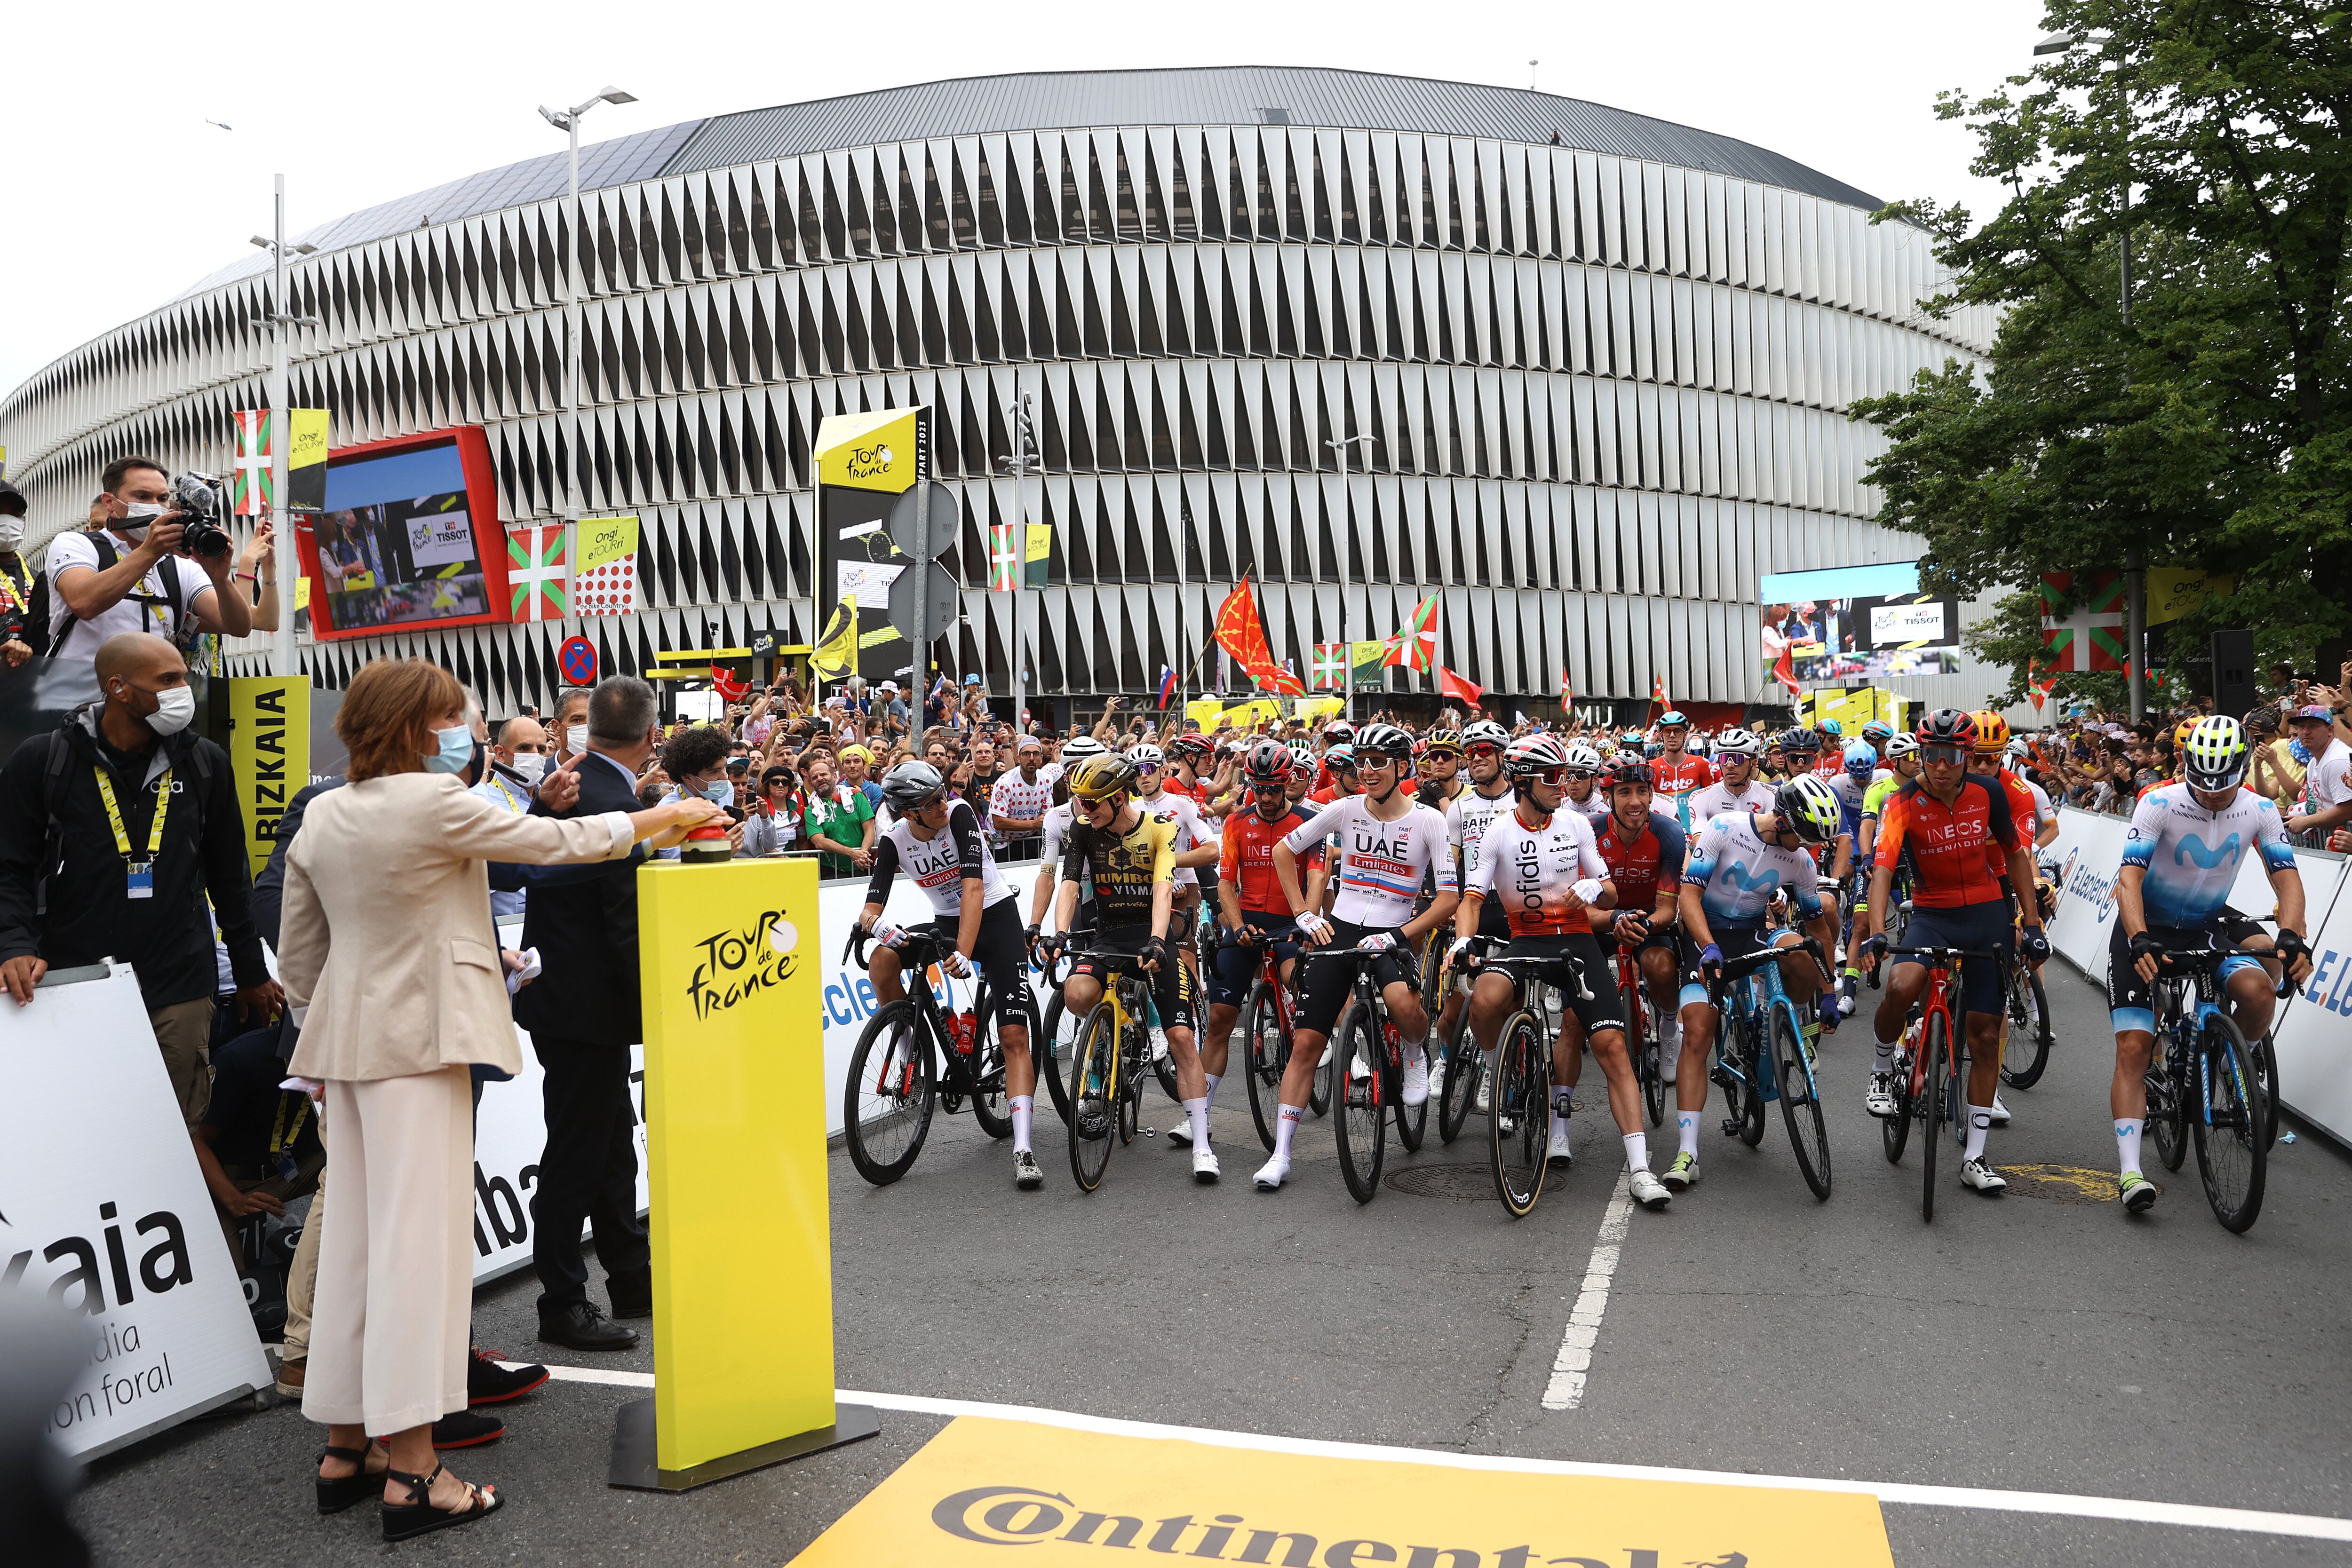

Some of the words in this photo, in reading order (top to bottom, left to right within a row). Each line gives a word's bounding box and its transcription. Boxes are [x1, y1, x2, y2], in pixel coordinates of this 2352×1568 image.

[299, 429, 319, 442] Ongi
[918, 449, 926, 480] ÉPART
[436, 530, 468, 542] TISSOT
[596, 526, 619, 544] Ongi
[588, 537, 624, 560] eTOURri
[2173, 574, 2206, 594] Ongi
[1904, 617, 1940, 625] TISSOT
[1133, 698, 1153, 711] 20
[255, 688, 286, 841] BIZKAIA
[906, 779, 927, 790] MET
[2171, 808, 2208, 823] CANYON
[1926, 819, 1982, 843] INEOS
[1356, 833, 1408, 861] UAE
[1549, 844, 1579, 853] LOOK
[1732, 837, 1757, 855] CANYON
[914, 848, 959, 875] UAE
[1354, 857, 1406, 874] Emirates
[922, 869, 961, 887] Emirate
[1095, 872, 1153, 884] JUMBO
[1515, 840, 1546, 924] cofidis
[2069, 864, 2108, 906] E.Leclerc
[878, 926, 891, 939] UAE
[758, 946, 772, 965] de
[1019, 969, 1028, 1002] UAE
[1178, 958, 1189, 1004] JUMBO
[2107, 969, 2115, 1006] Telefónica
[1006, 1008, 1028, 1017] Emira
[1590, 1019, 1625, 1030] CORIMA
[101, 1352, 173, 1417] foral
[931, 1486, 1659, 1568] Continent
